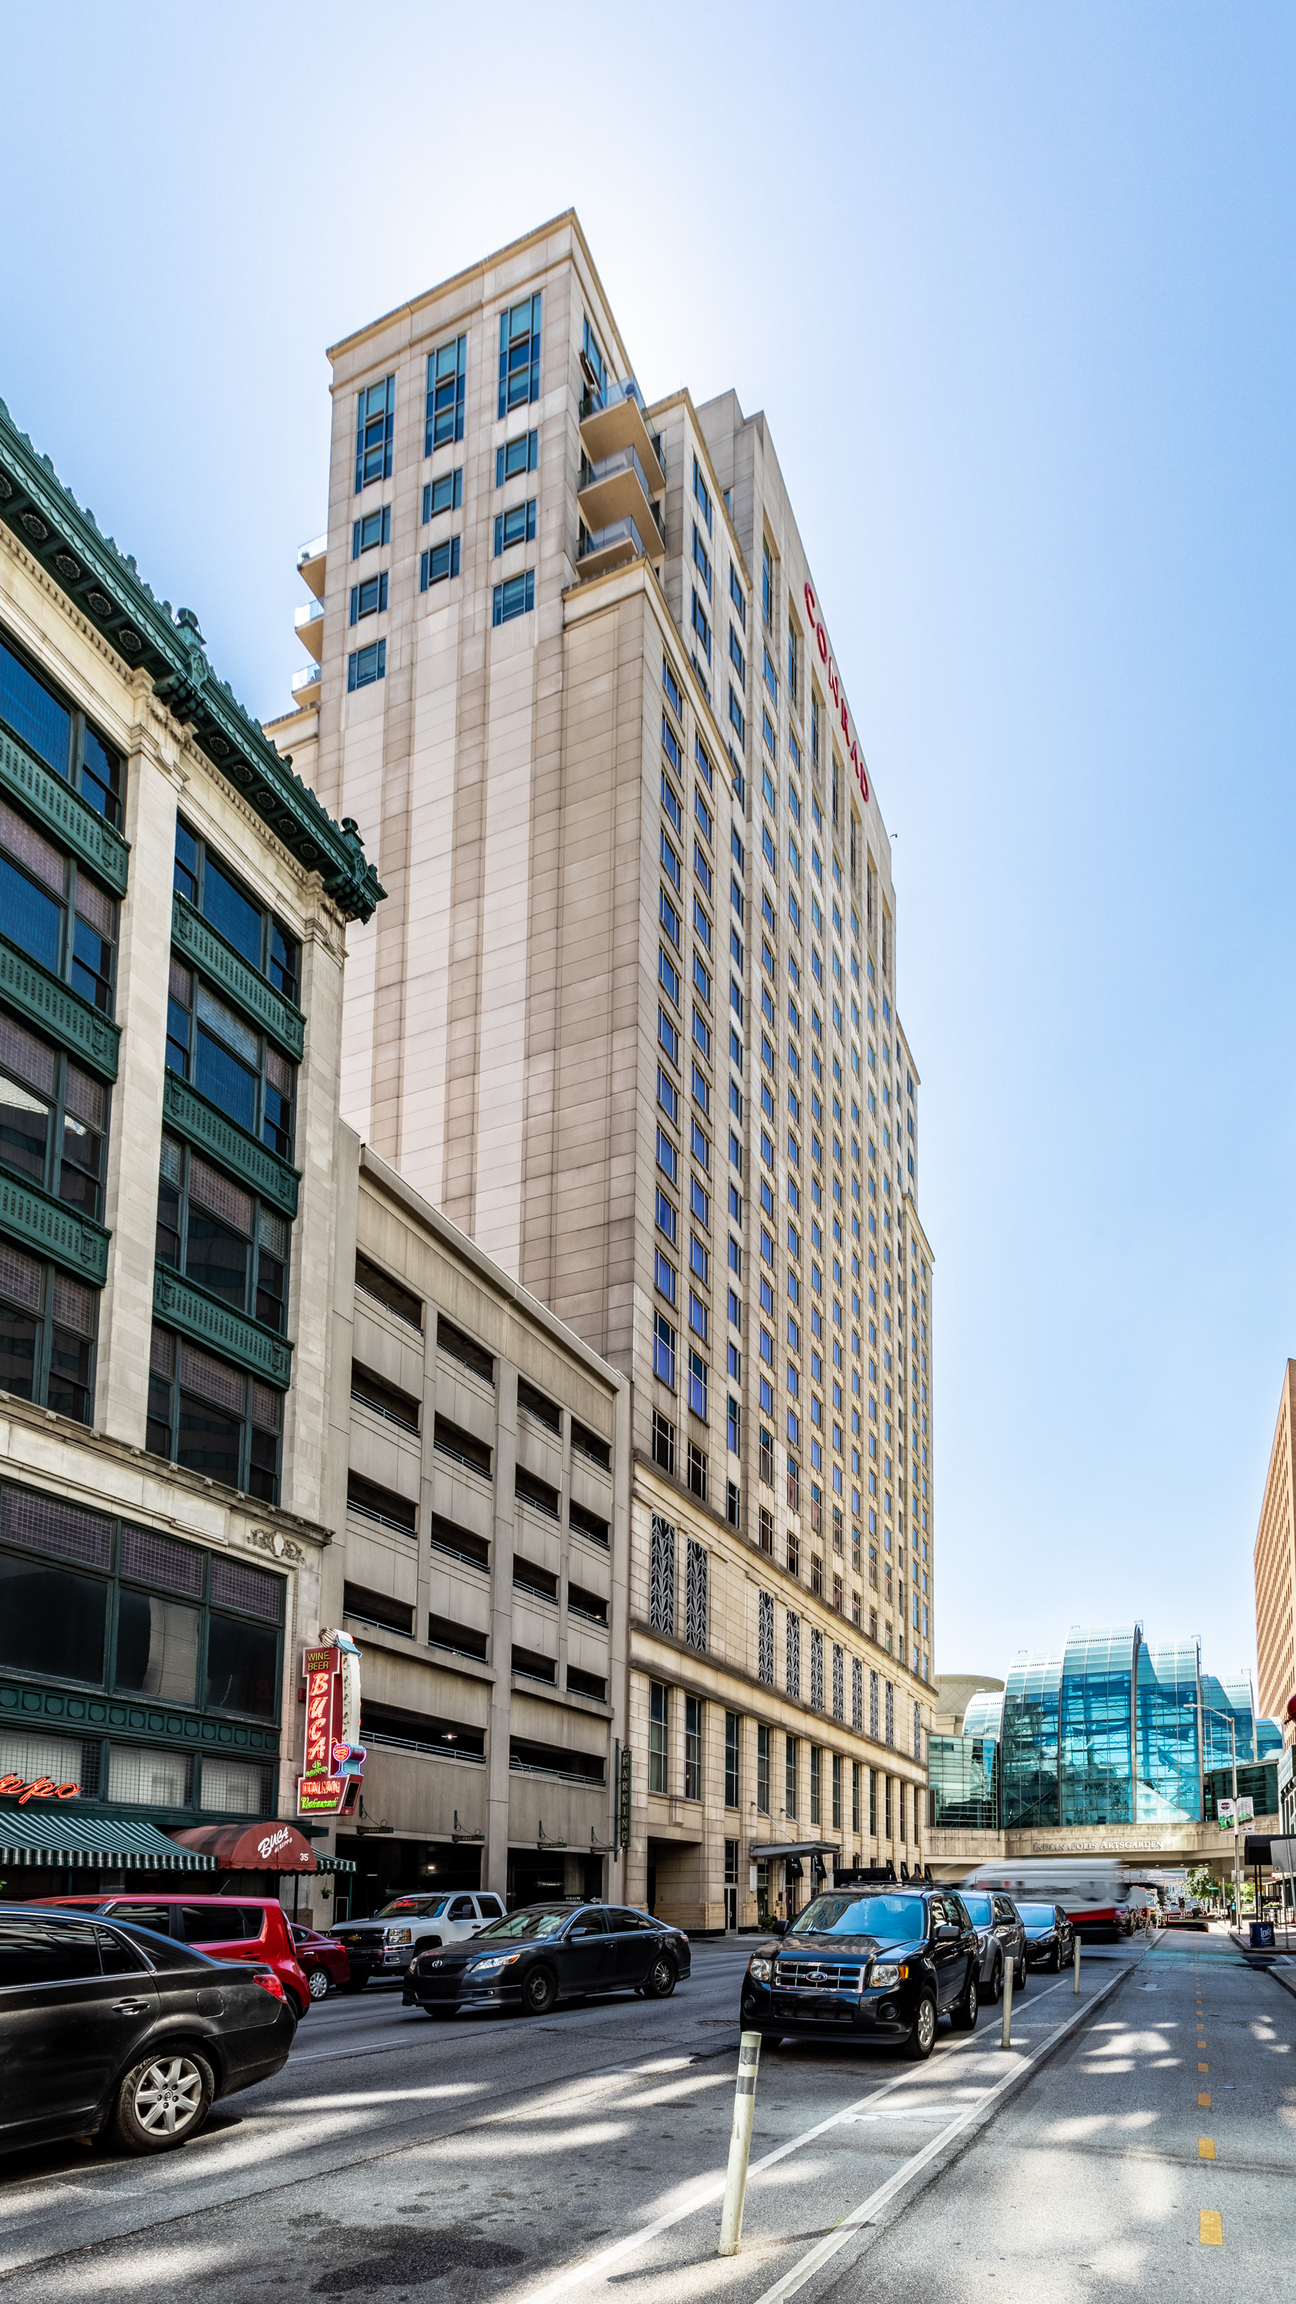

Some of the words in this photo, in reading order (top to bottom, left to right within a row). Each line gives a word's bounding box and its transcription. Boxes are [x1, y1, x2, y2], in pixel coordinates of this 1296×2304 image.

[804, 582, 870, 803] CONRAD
[307, 1651, 331, 1662] WINE
[307, 1661, 330, 1671] BEER
[308, 1672, 329, 1760] BUCA
[302, 1781, 341, 1795] ITALIAN
[621, 1757, 629, 1841] PARKING
[257, 1826, 289, 1859] BUCA
[1100, 1840, 1163, 1850] ARTSGARDEN
[299, 1852, 309, 1862] 35
